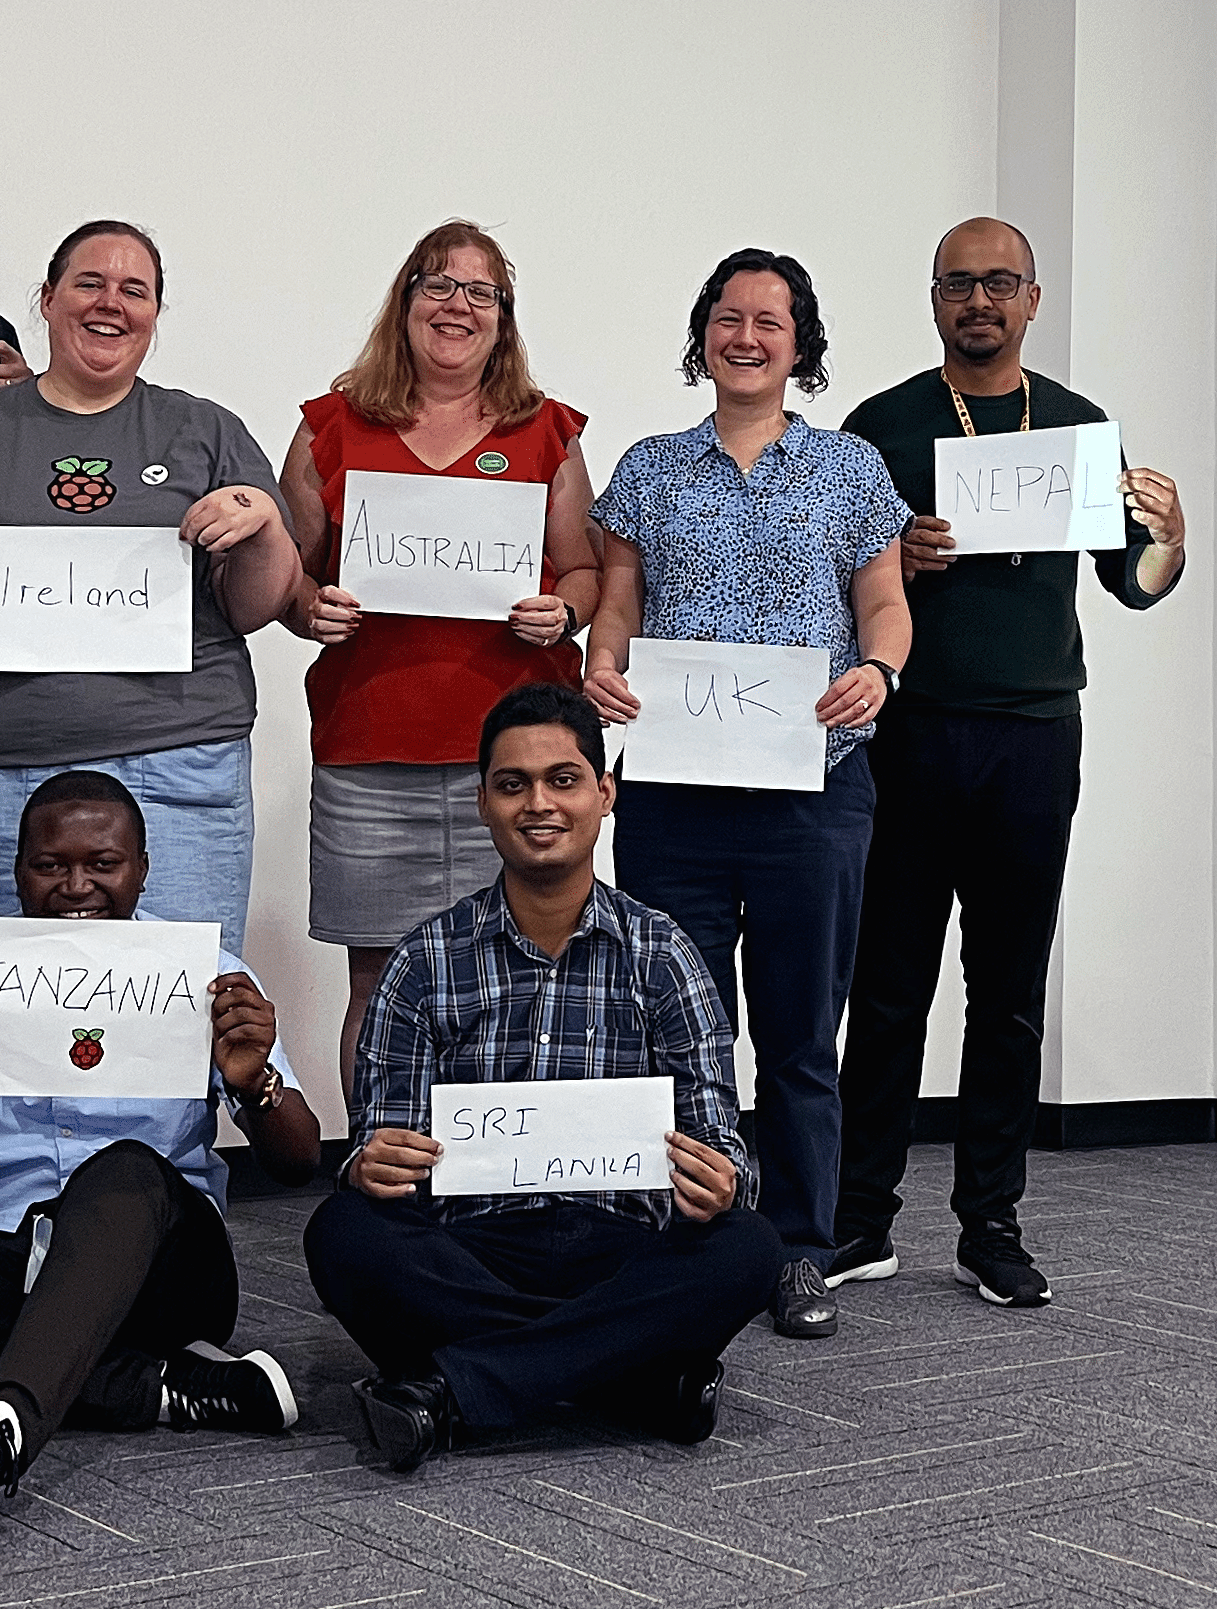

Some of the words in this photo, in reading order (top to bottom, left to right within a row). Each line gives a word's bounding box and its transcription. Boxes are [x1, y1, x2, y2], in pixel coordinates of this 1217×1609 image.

[955, 463, 1114, 513] NEPAL
[343, 498, 535, 578] AUSTRALIA
[2, 562, 149, 609] Ireland
[684, 672, 782, 723] UK
[451, 1107, 538, 1141] SRI
